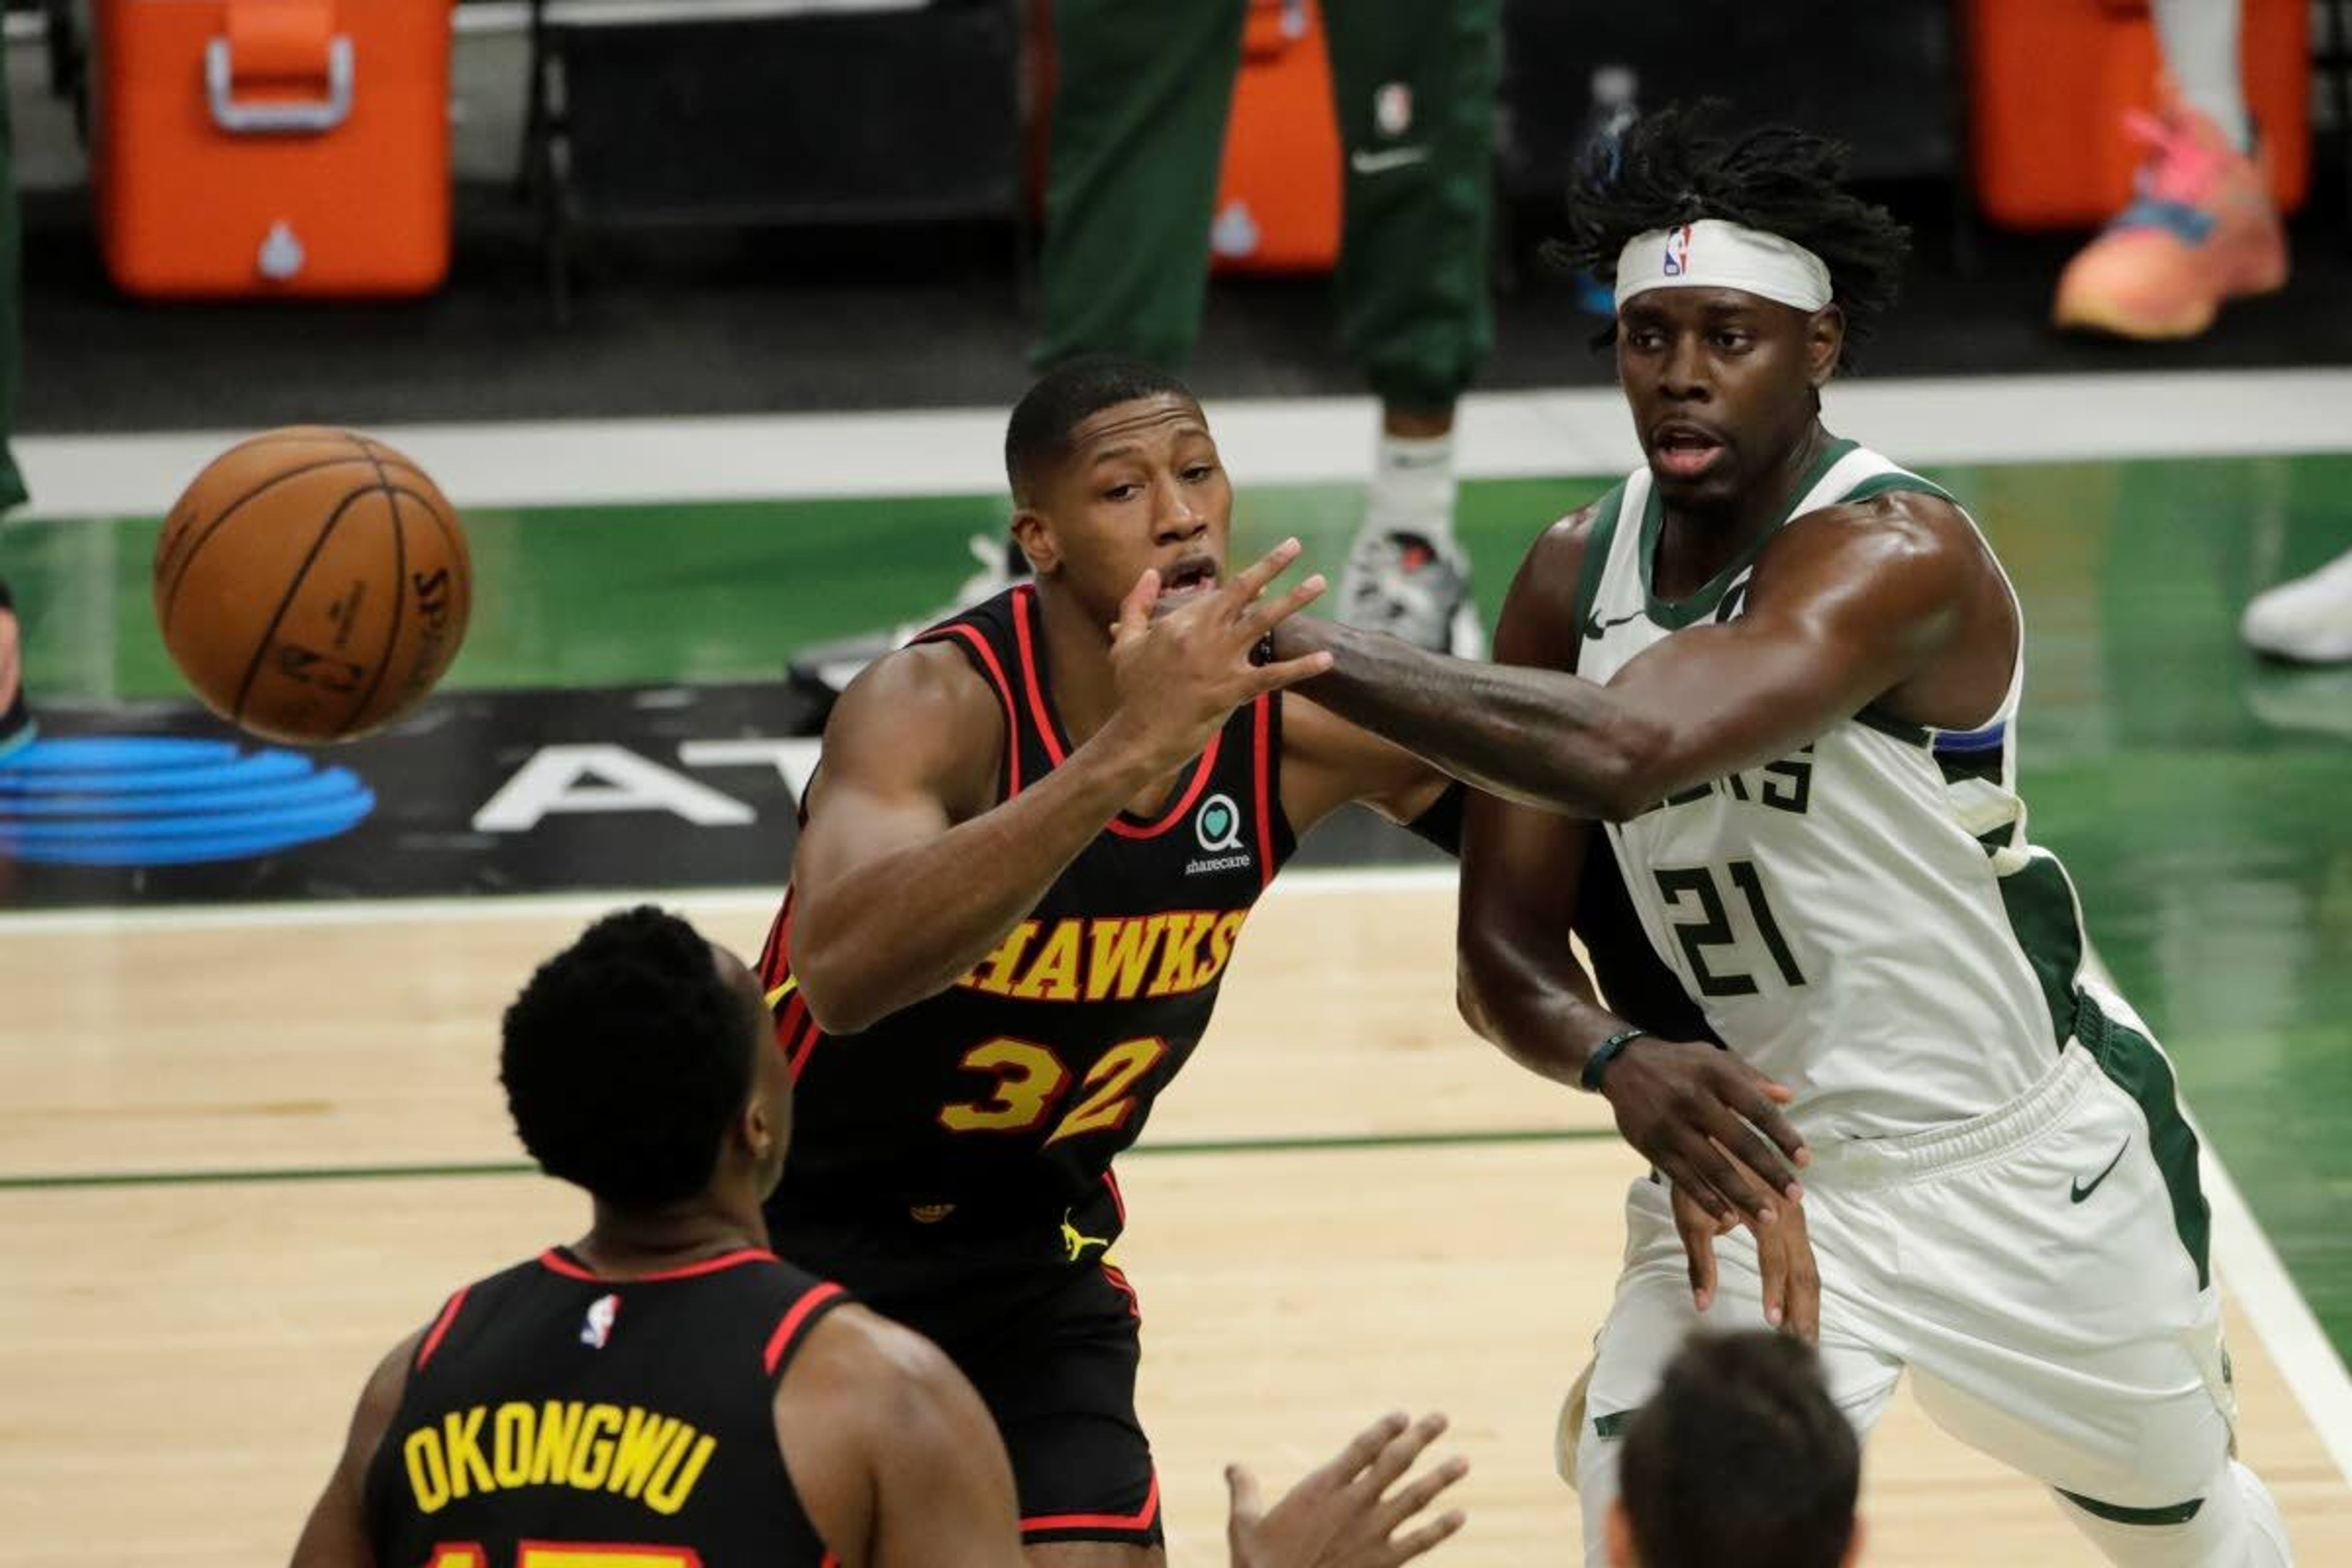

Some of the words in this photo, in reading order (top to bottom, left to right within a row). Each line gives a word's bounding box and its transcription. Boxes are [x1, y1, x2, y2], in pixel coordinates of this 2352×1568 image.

[1185, 853, 1251, 875] sharecare
[957, 908, 1246, 1003] HAWKS
[1653, 861, 1807, 997] 21
[938, 1034, 1170, 1147] 32
[402, 1400, 718, 1516] OKONGWU
